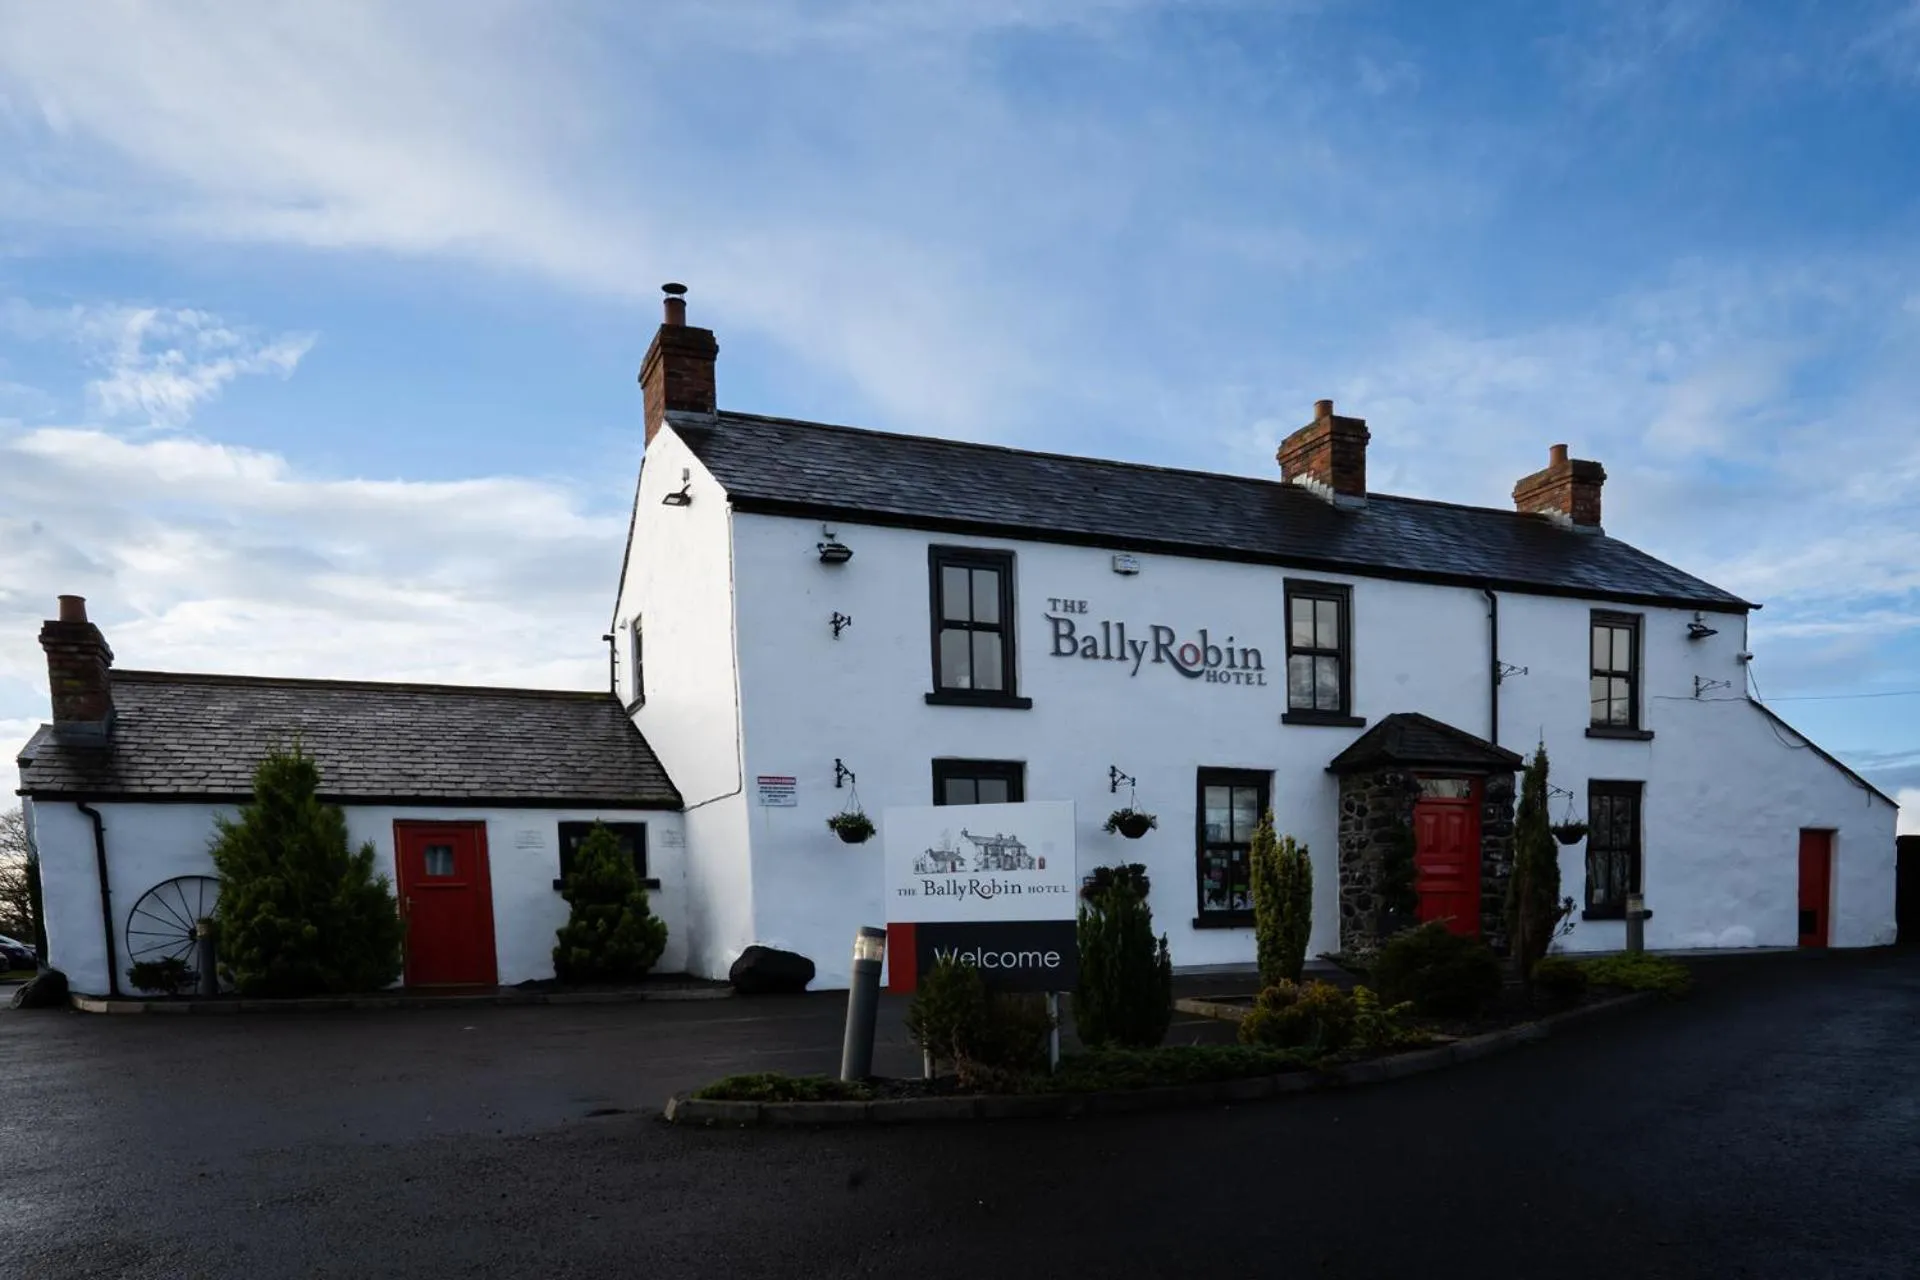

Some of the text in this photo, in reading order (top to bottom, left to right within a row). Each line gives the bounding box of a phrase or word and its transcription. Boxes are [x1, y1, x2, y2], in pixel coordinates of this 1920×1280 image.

[1047, 598, 1088, 614] THE
[1044, 612, 1265, 679] BallyRobin
[1206, 670, 1267, 686] HOTEL
[897, 879, 1069, 900] THE BallyRobin HOTEL
[934, 946, 1060, 968] Welcome
